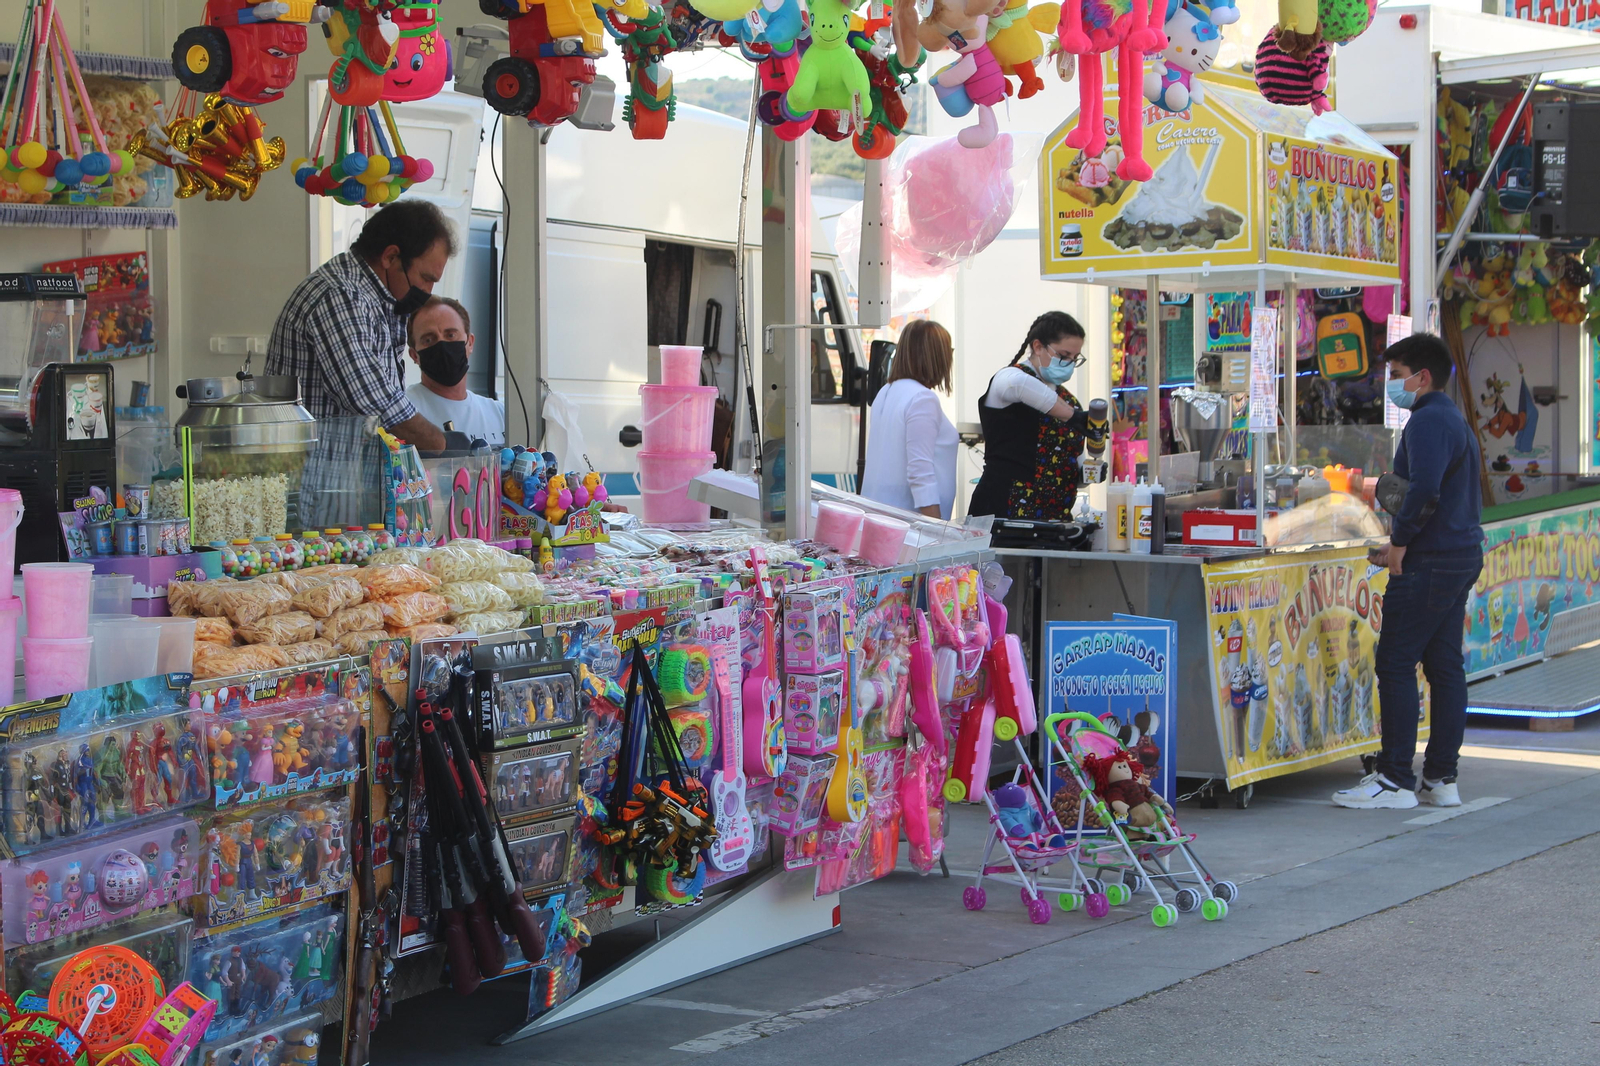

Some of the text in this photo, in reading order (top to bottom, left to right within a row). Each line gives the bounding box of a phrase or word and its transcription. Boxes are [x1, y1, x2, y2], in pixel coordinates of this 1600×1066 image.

[1156, 122, 1218, 143] Casero
[1157, 142, 1175, 151] COMO
[1175, 138, 1196, 147] HECHO
[1206, 137, 1222, 145] CASA
[1291, 142, 1377, 192] BUÑUELOS
[1059, 208, 1094, 219] nutella
[37, 278, 74, 287] natfood
[501, 516, 538, 530] FLASH
[570, 515, 600, 530] FLASH
[1476, 531, 1561, 595] SIEMPRE
[1283, 565, 1384, 651] BUÑUELOS
[1053, 630, 1166, 676] GARRAPIÑADAS
[1053, 668, 1166, 697] PRODUCTO RECIÉN HECHOS
[262, 688, 278, 698] RUN
[481, 690, 492, 732] S.W.A.T.
[527, 729, 552, 743] S.W.A.T.
